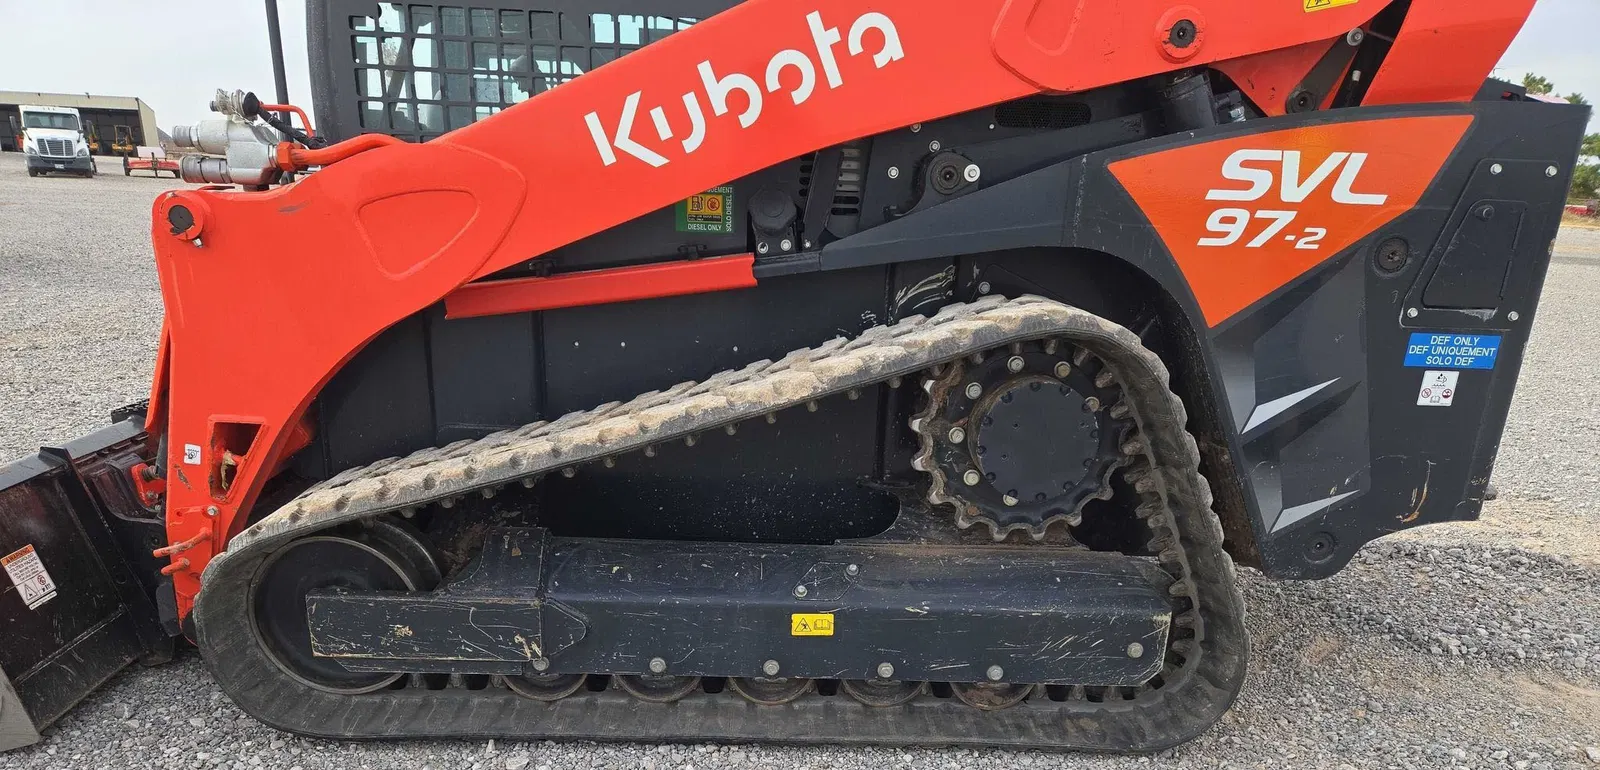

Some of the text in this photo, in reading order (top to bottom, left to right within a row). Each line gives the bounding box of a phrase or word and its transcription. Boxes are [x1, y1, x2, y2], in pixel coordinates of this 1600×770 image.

[584, 10, 905, 168] Kubota
[1205, 149, 1388, 205] SVL
[688, 223, 706, 231] DIESEL
[1197, 208, 1327, 249] 97-2
[1430, 335, 1480, 346] DEF ONLY
[1409, 345, 1496, 356] DEF UNIQUEMENT
[1426, 356, 1475, 366] SOLO DEF
